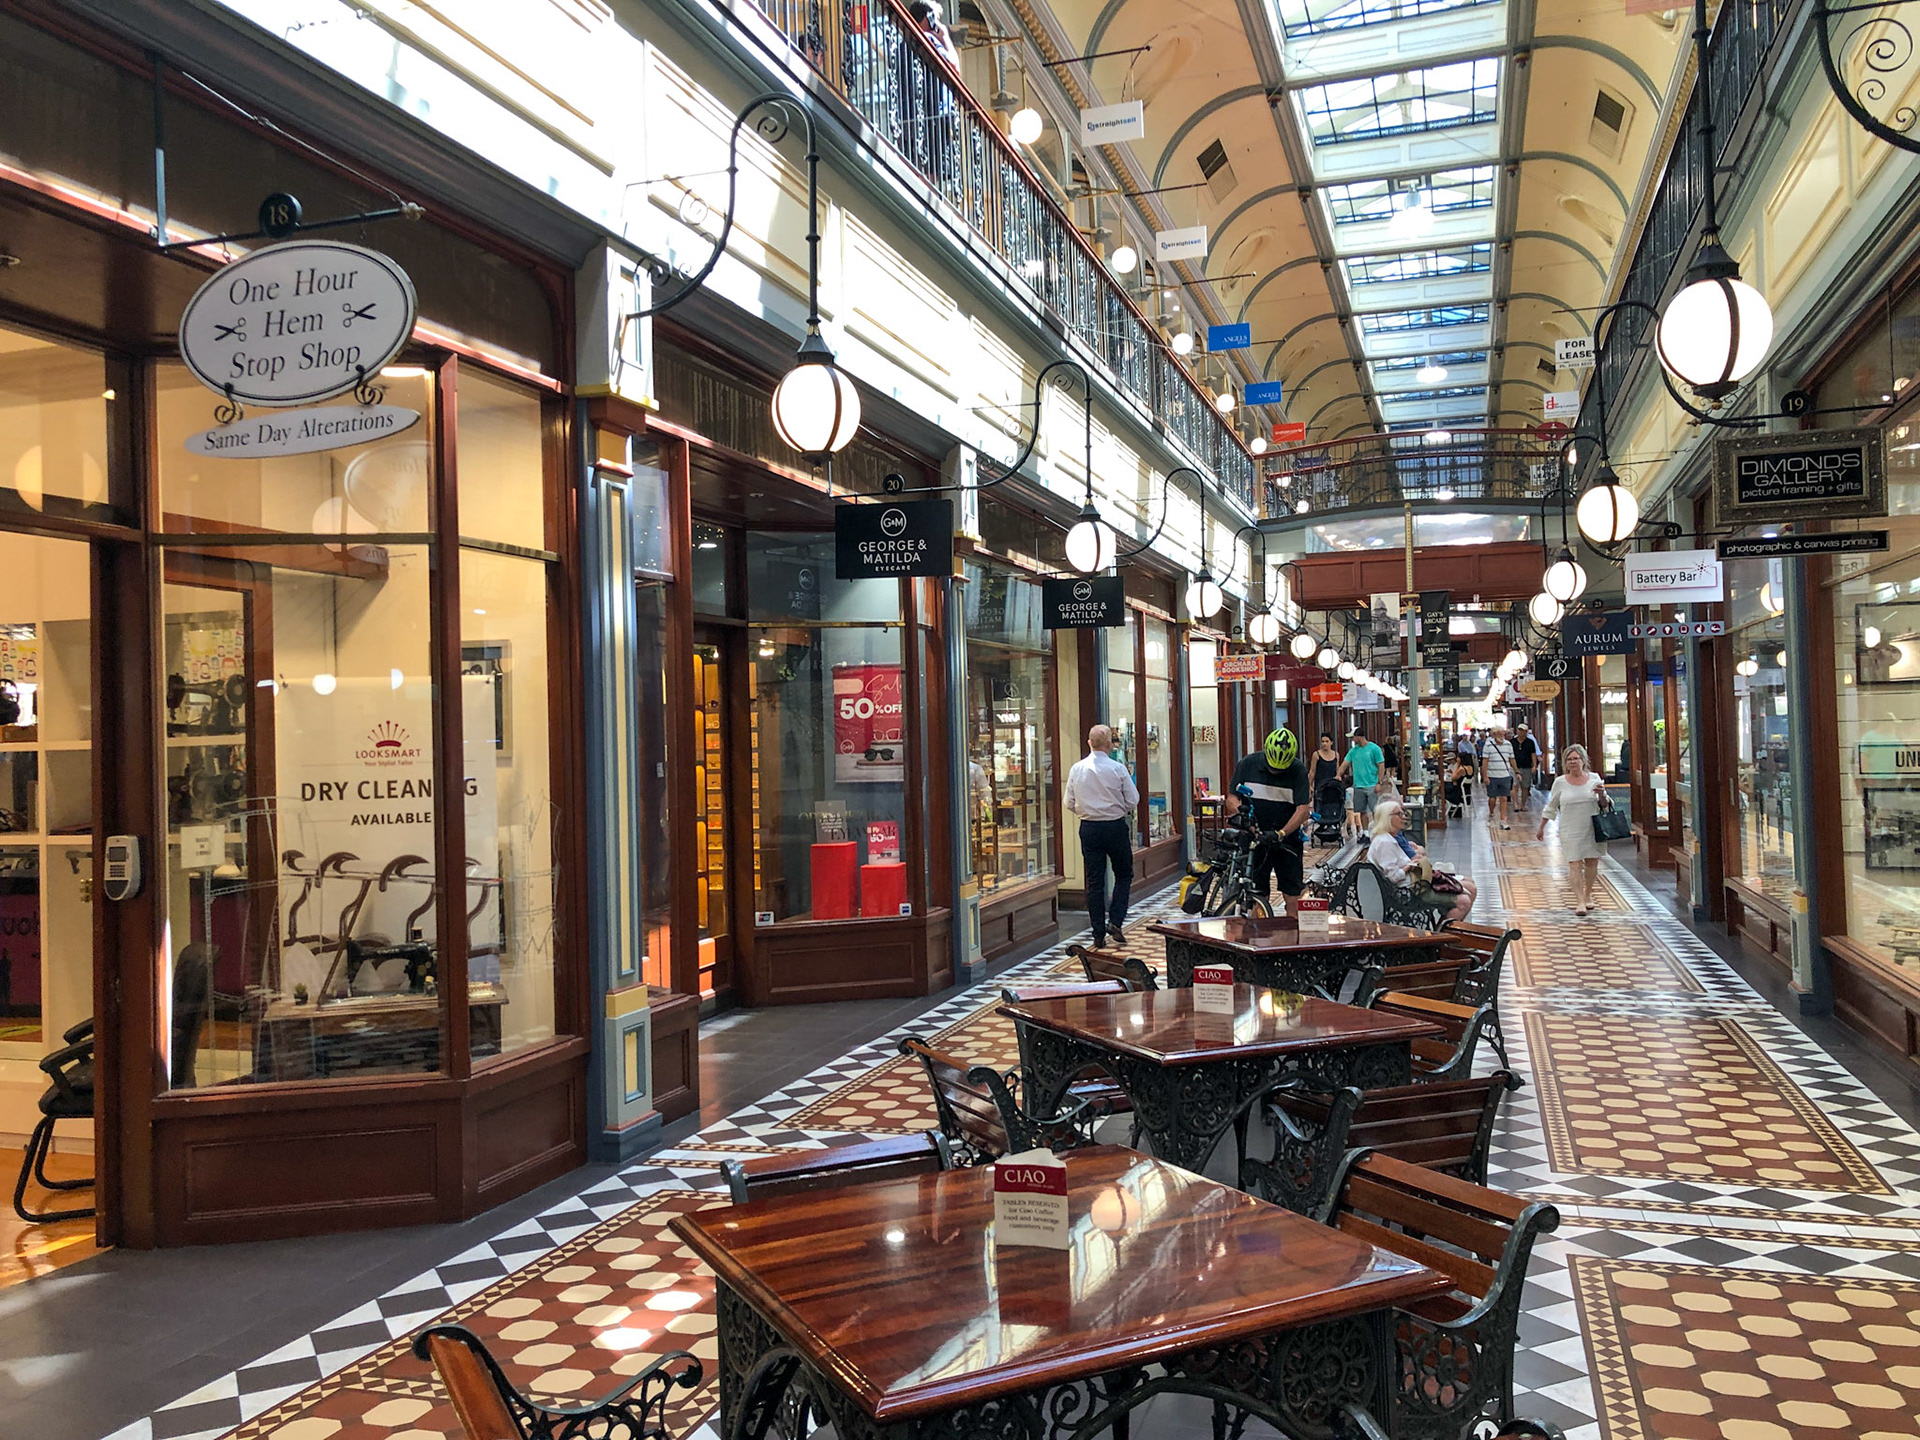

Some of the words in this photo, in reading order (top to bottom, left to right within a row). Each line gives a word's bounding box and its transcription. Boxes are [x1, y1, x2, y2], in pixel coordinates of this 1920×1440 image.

[269, 204, 289, 226] 18
[229, 277, 280, 306] One
[293, 268, 358, 298] Hour
[262, 309, 323, 338] Hem
[1564, 340, 1586, 349] FOR
[229, 352, 285, 382] Stop
[299, 342, 361, 375] Shop
[1559, 350, 1592, 360] LEASE
[1788, 397, 1804, 412] 19
[204, 430, 250, 451] Same
[257, 423, 292, 446] Day
[297, 411, 394, 439] Alterations
[1741, 453, 1861, 476] DIMONDS
[1754, 468, 1847, 487] GALLERY
[887, 480, 900, 491] 20
[1742, 485, 1780, 499] picture
[1782, 482, 1825, 495] framing
[1836, 481, 1862, 493] gifts
[1667, 527, 1678, 535] 21
[858, 539, 915, 553] GEORGE
[917, 539, 928, 551] &
[1726, 541, 1792, 555] photographic
[1794, 540, 1802, 549] &
[1803, 540, 1840, 549] canvas
[1841, 537, 1879, 549] printing
[863, 552, 921, 565] MATILDA
[1636, 573, 1677, 585] Battery
[1679, 571, 1697, 582] Bar
[1058, 602, 1099, 612] GEORGE
[1100, 601, 1107, 610] &
[1062, 611, 1104, 620] MATILDA
[1423, 617, 1448, 625] ARCADE
[1574, 633, 1623, 645] AURUM
[1221, 666, 1259, 674] BOOKSHOP
[1223, 660, 1257, 668] ORCHARD
[355, 749, 422, 759] LOOKSMART
[1895, 751, 1920, 767] UN
[301, 781, 349, 802] DRY
[357, 778, 478, 800] CLEANG
[351, 812, 432, 826] AVAILABLE
[1198, 970, 1222, 980] CIAO
[1004, 1169, 1046, 1184] CIAO
